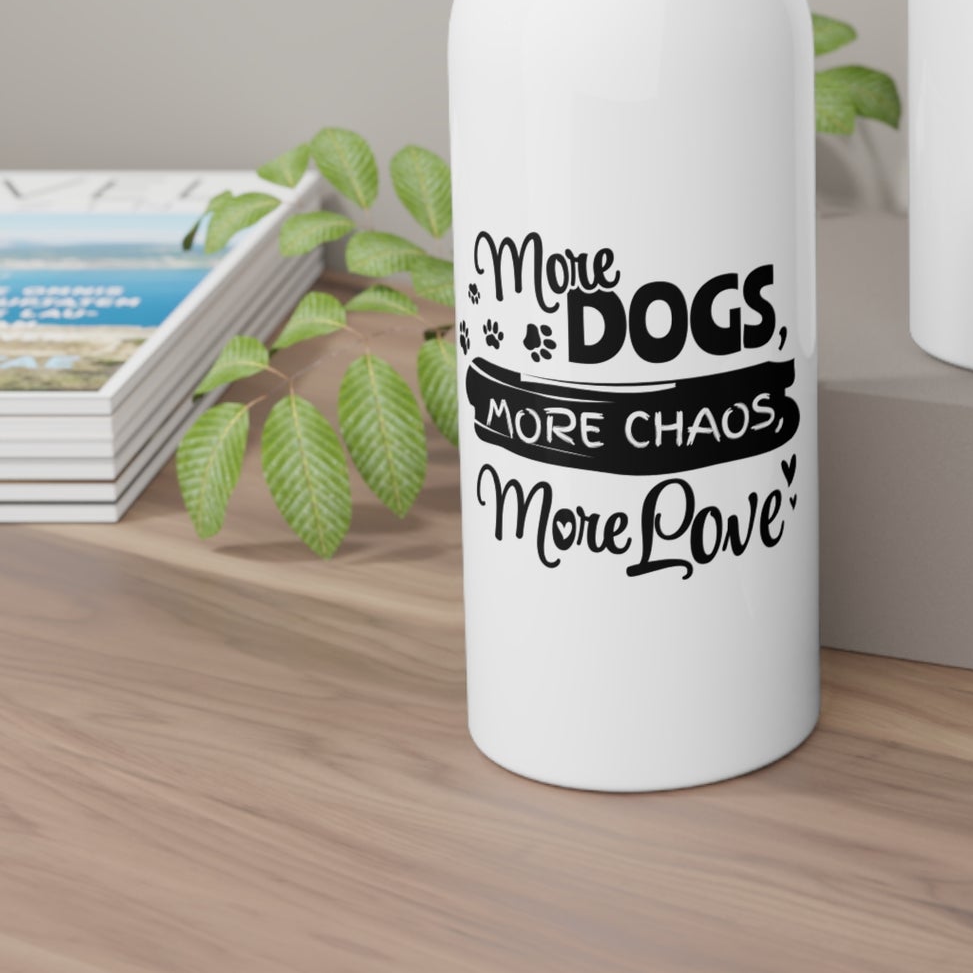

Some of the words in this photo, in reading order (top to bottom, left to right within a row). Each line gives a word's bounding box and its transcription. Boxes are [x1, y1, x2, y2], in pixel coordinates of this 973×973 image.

[474, 231, 620, 313] More
[567, 264, 787, 364] DOGS,
[487, 398, 604, 448] MORE
[624, 393, 783, 449] CHAOS,
[477, 464, 632, 568] More
[626, 478, 785, 580] Love
